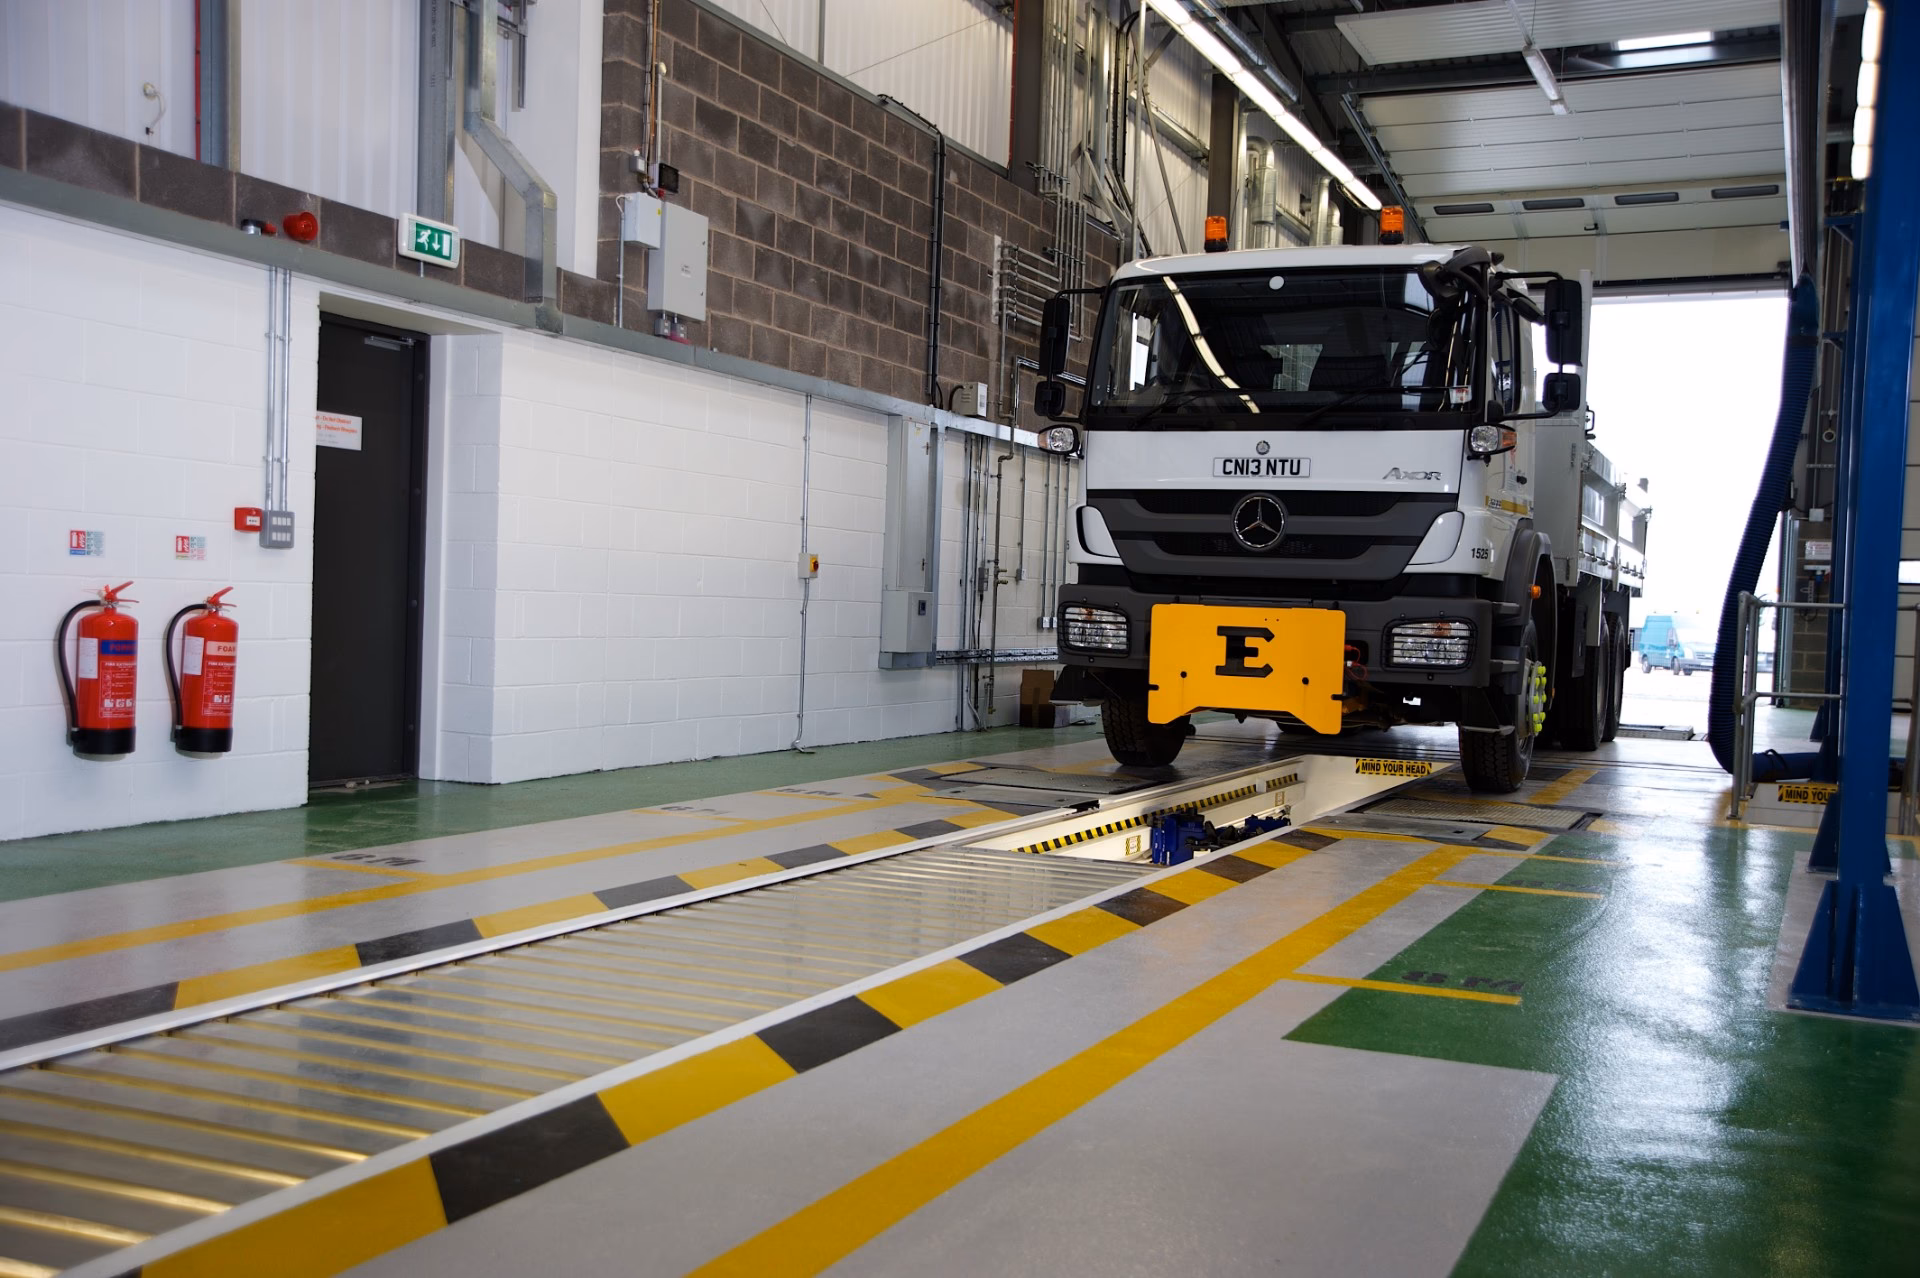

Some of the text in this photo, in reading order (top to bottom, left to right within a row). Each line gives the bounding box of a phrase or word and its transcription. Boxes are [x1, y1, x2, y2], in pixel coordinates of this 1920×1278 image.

[1222, 458, 1301, 476] CN13 NTU
[1471, 547, 1489, 560] 1525
[1215, 625, 1275, 678] E
[1361, 761, 1426, 774] MIND YOUR HEAD
[1785, 789, 1829, 801] MIND YOU
